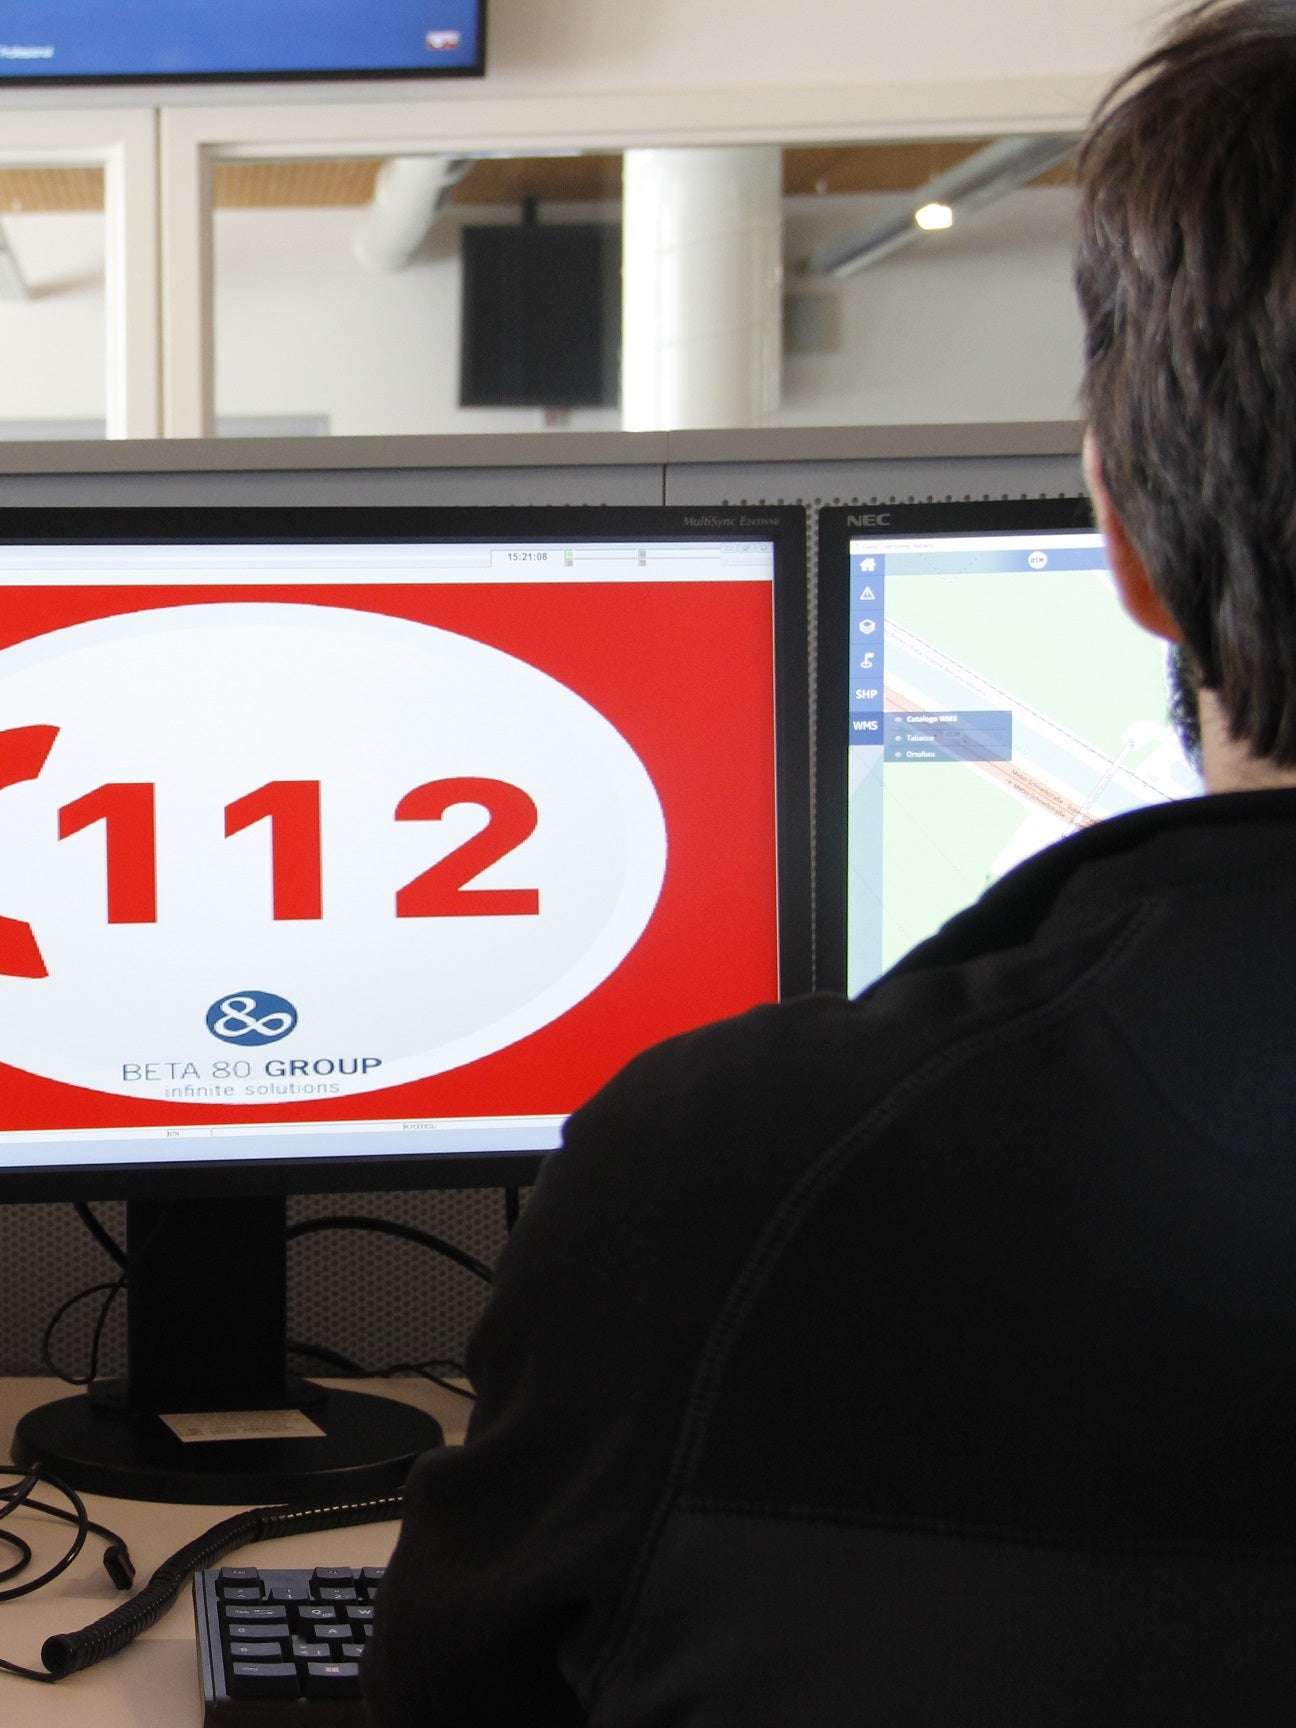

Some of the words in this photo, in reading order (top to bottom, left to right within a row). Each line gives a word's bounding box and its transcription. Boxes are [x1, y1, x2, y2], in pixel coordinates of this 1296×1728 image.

[683, 515, 735, 528] MultiSync
[847, 513, 890, 527] NEC
[507, 552, 548, 561] 15:21:08
[855, 689, 878, 699] SHP
[853, 720, 878, 731] WMS
[906, 715, 938, 724] Catalogo
[939, 715, 957, 723] WMS
[122, 1062, 200, 1082] BETA
[212, 1060, 251, 1079] 80
[265, 1057, 382, 1077] GROUP
[165, 1084, 234, 1098] infinite
[245, 1082, 340, 1096] solutions
